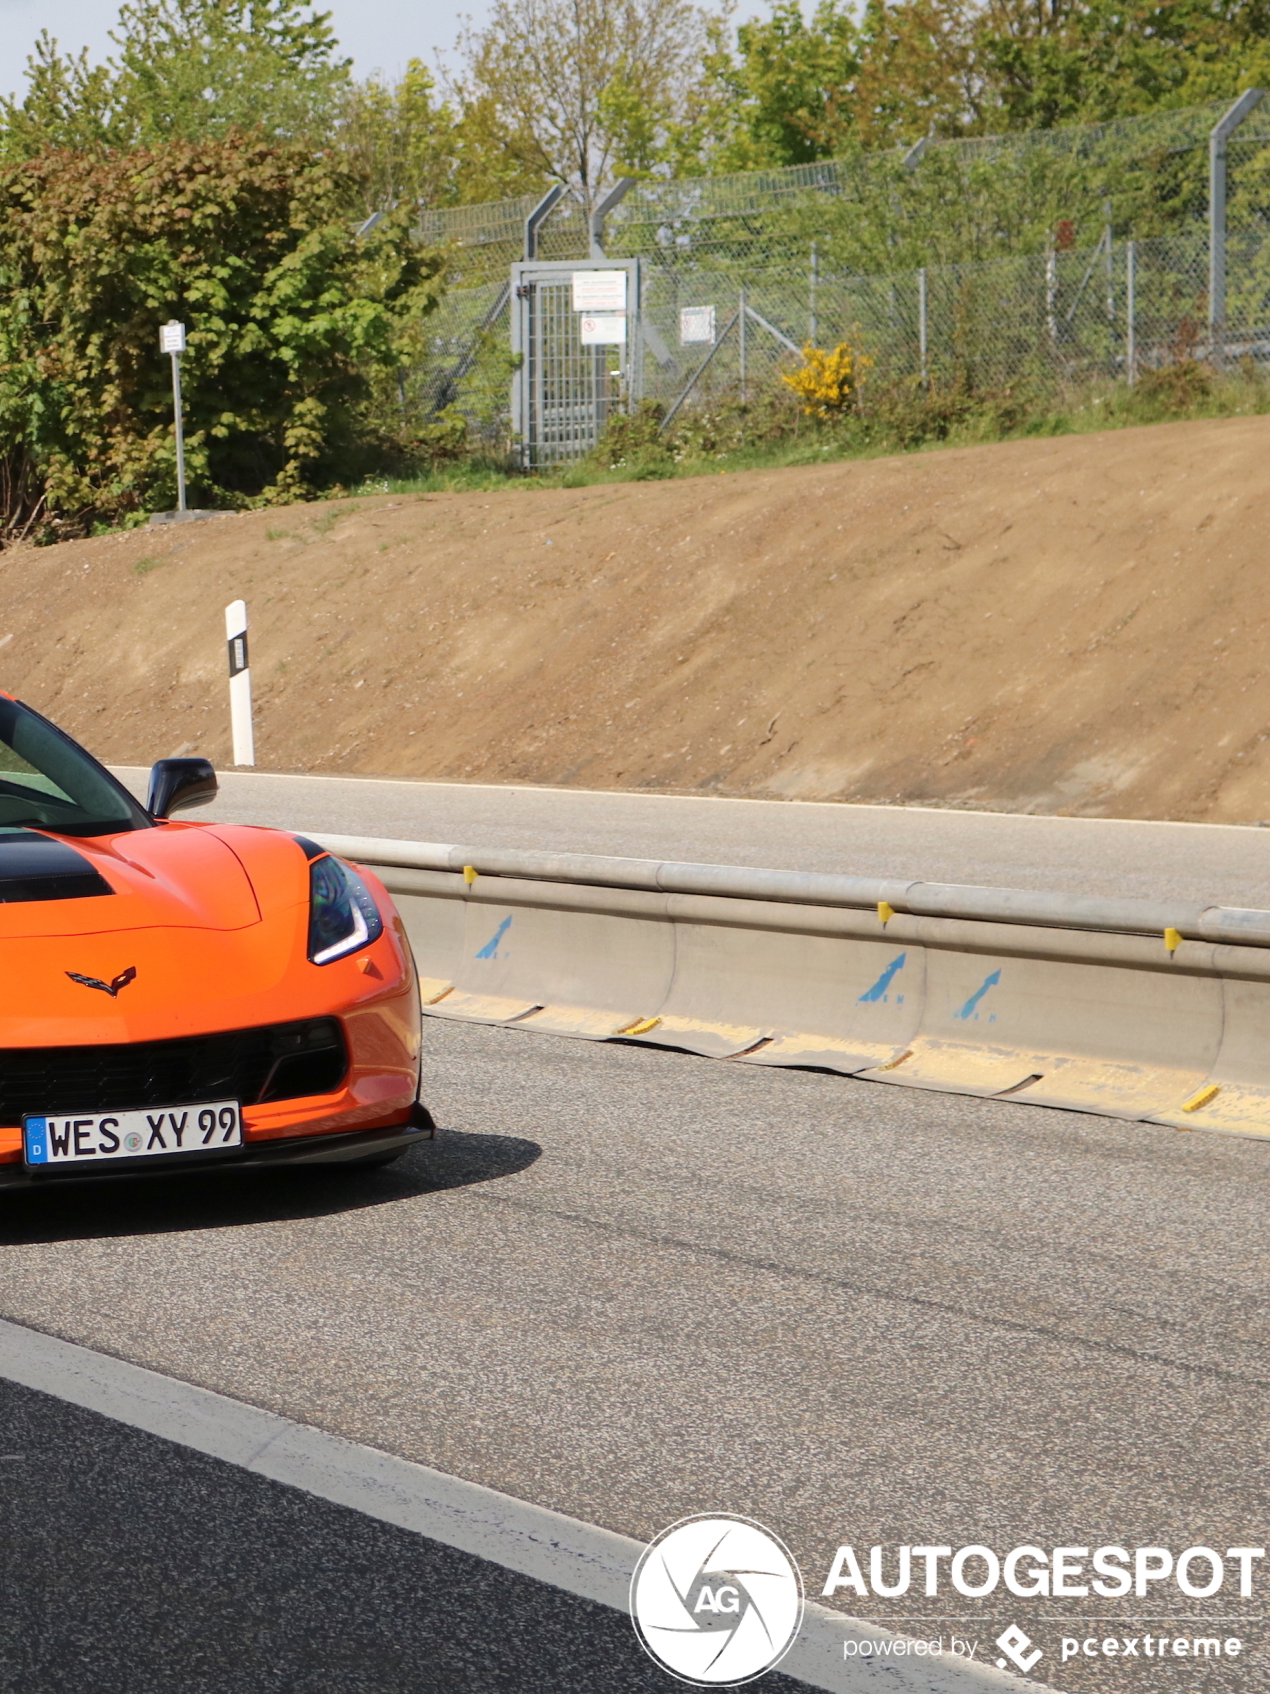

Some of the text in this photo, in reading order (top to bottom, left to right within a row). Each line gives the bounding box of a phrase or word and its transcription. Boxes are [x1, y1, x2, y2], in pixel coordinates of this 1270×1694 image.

[48, 1107, 237, 1157] WES XY 99
[33, 1145, 41, 1156] D
